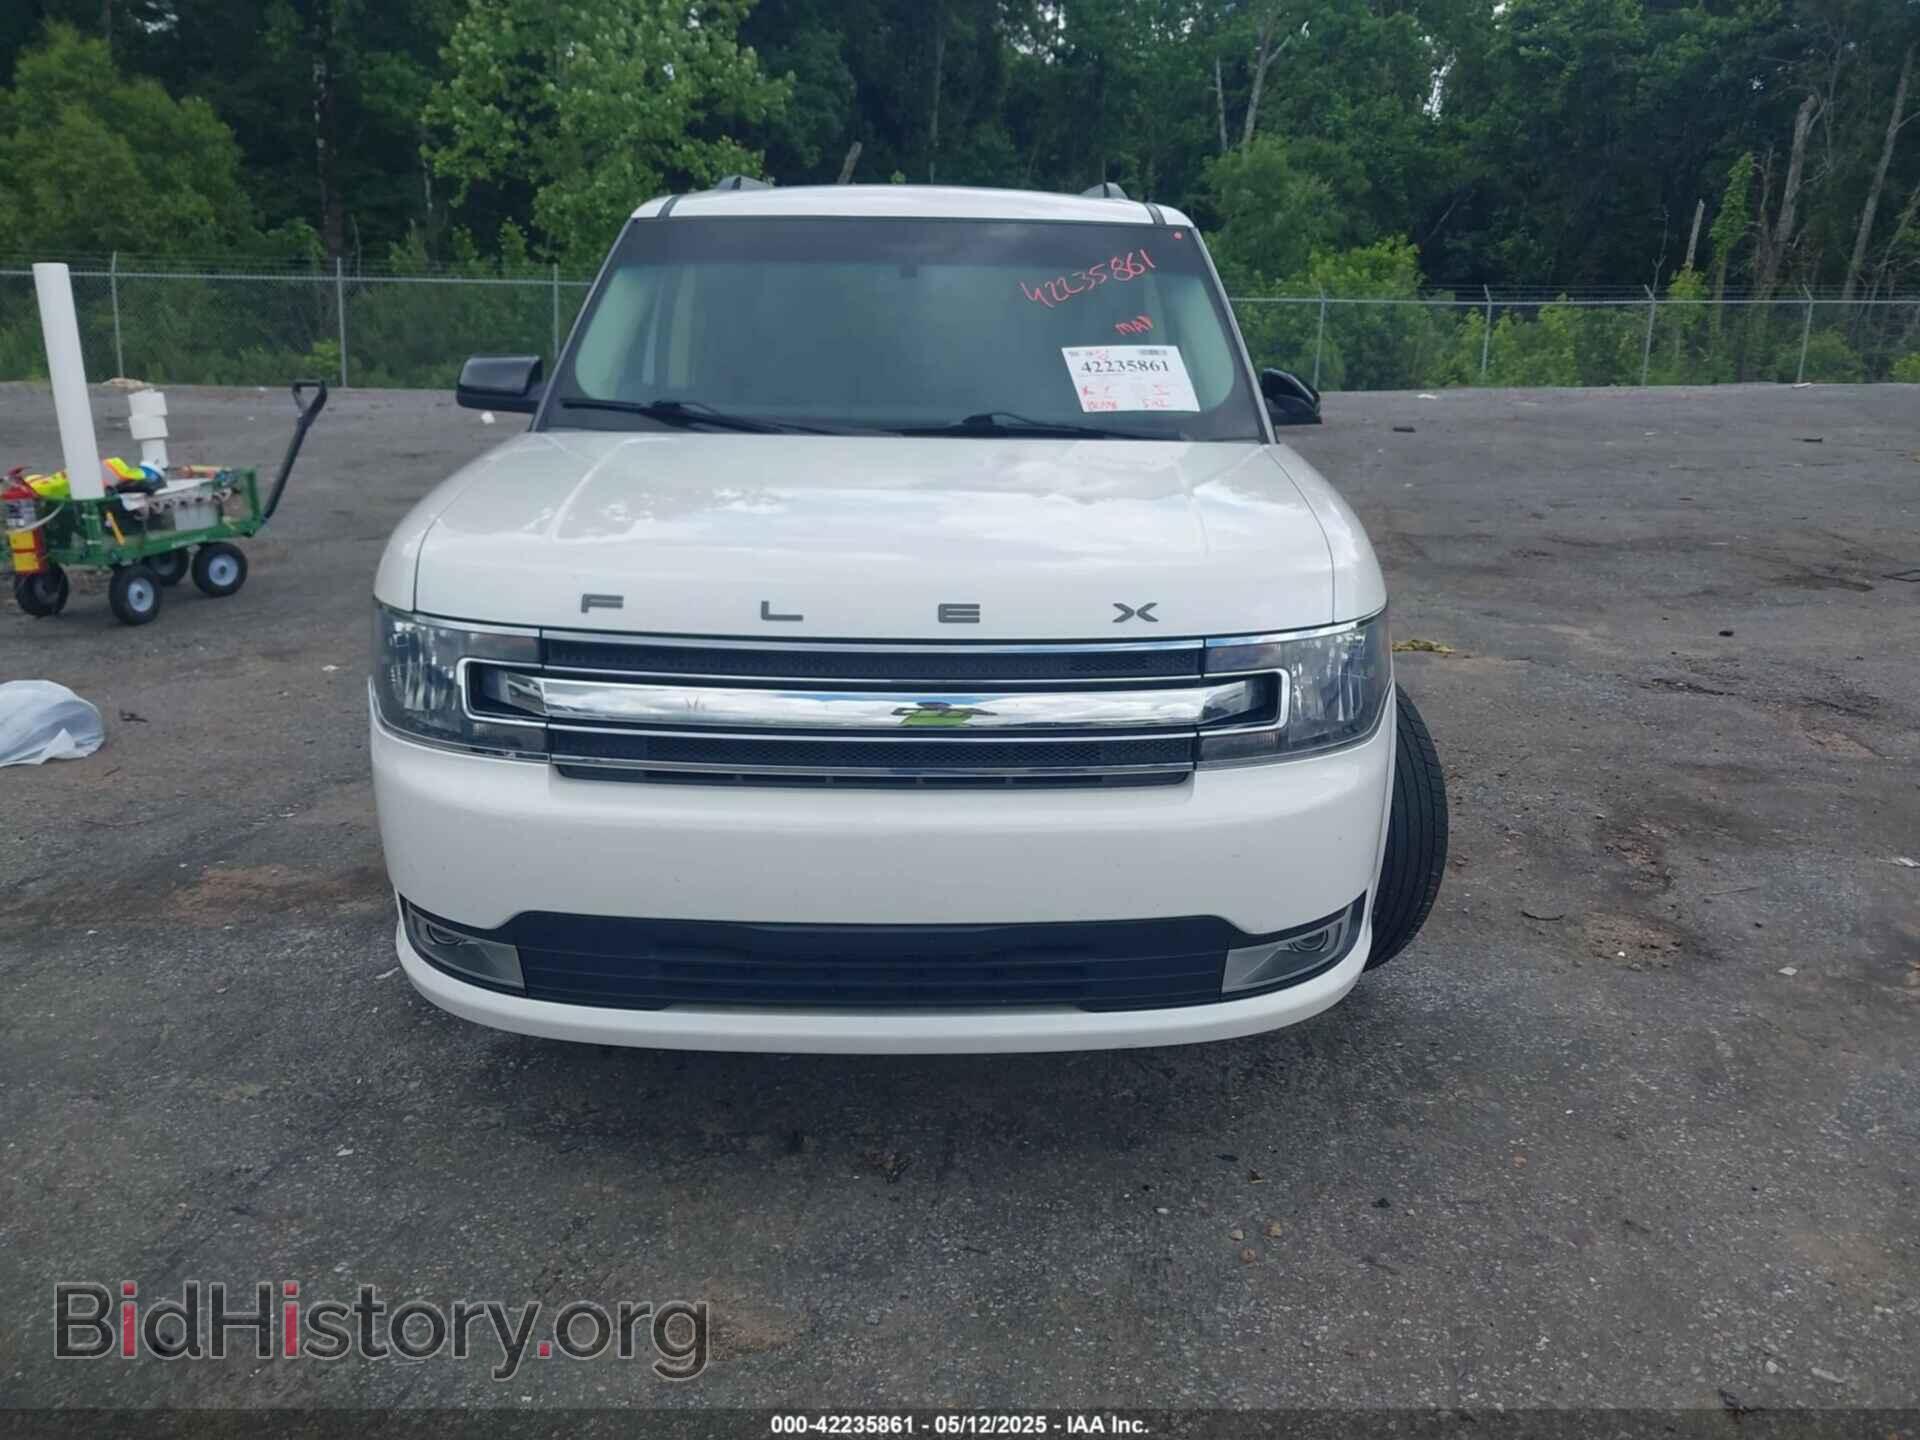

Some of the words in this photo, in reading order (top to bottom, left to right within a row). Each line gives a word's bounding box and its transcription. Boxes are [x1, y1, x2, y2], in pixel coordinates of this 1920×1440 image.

[1020, 249, 1156, 308] 42235861
[1081, 360, 1169, 373] 42235861
[581, 595, 1158, 623] FLEX
